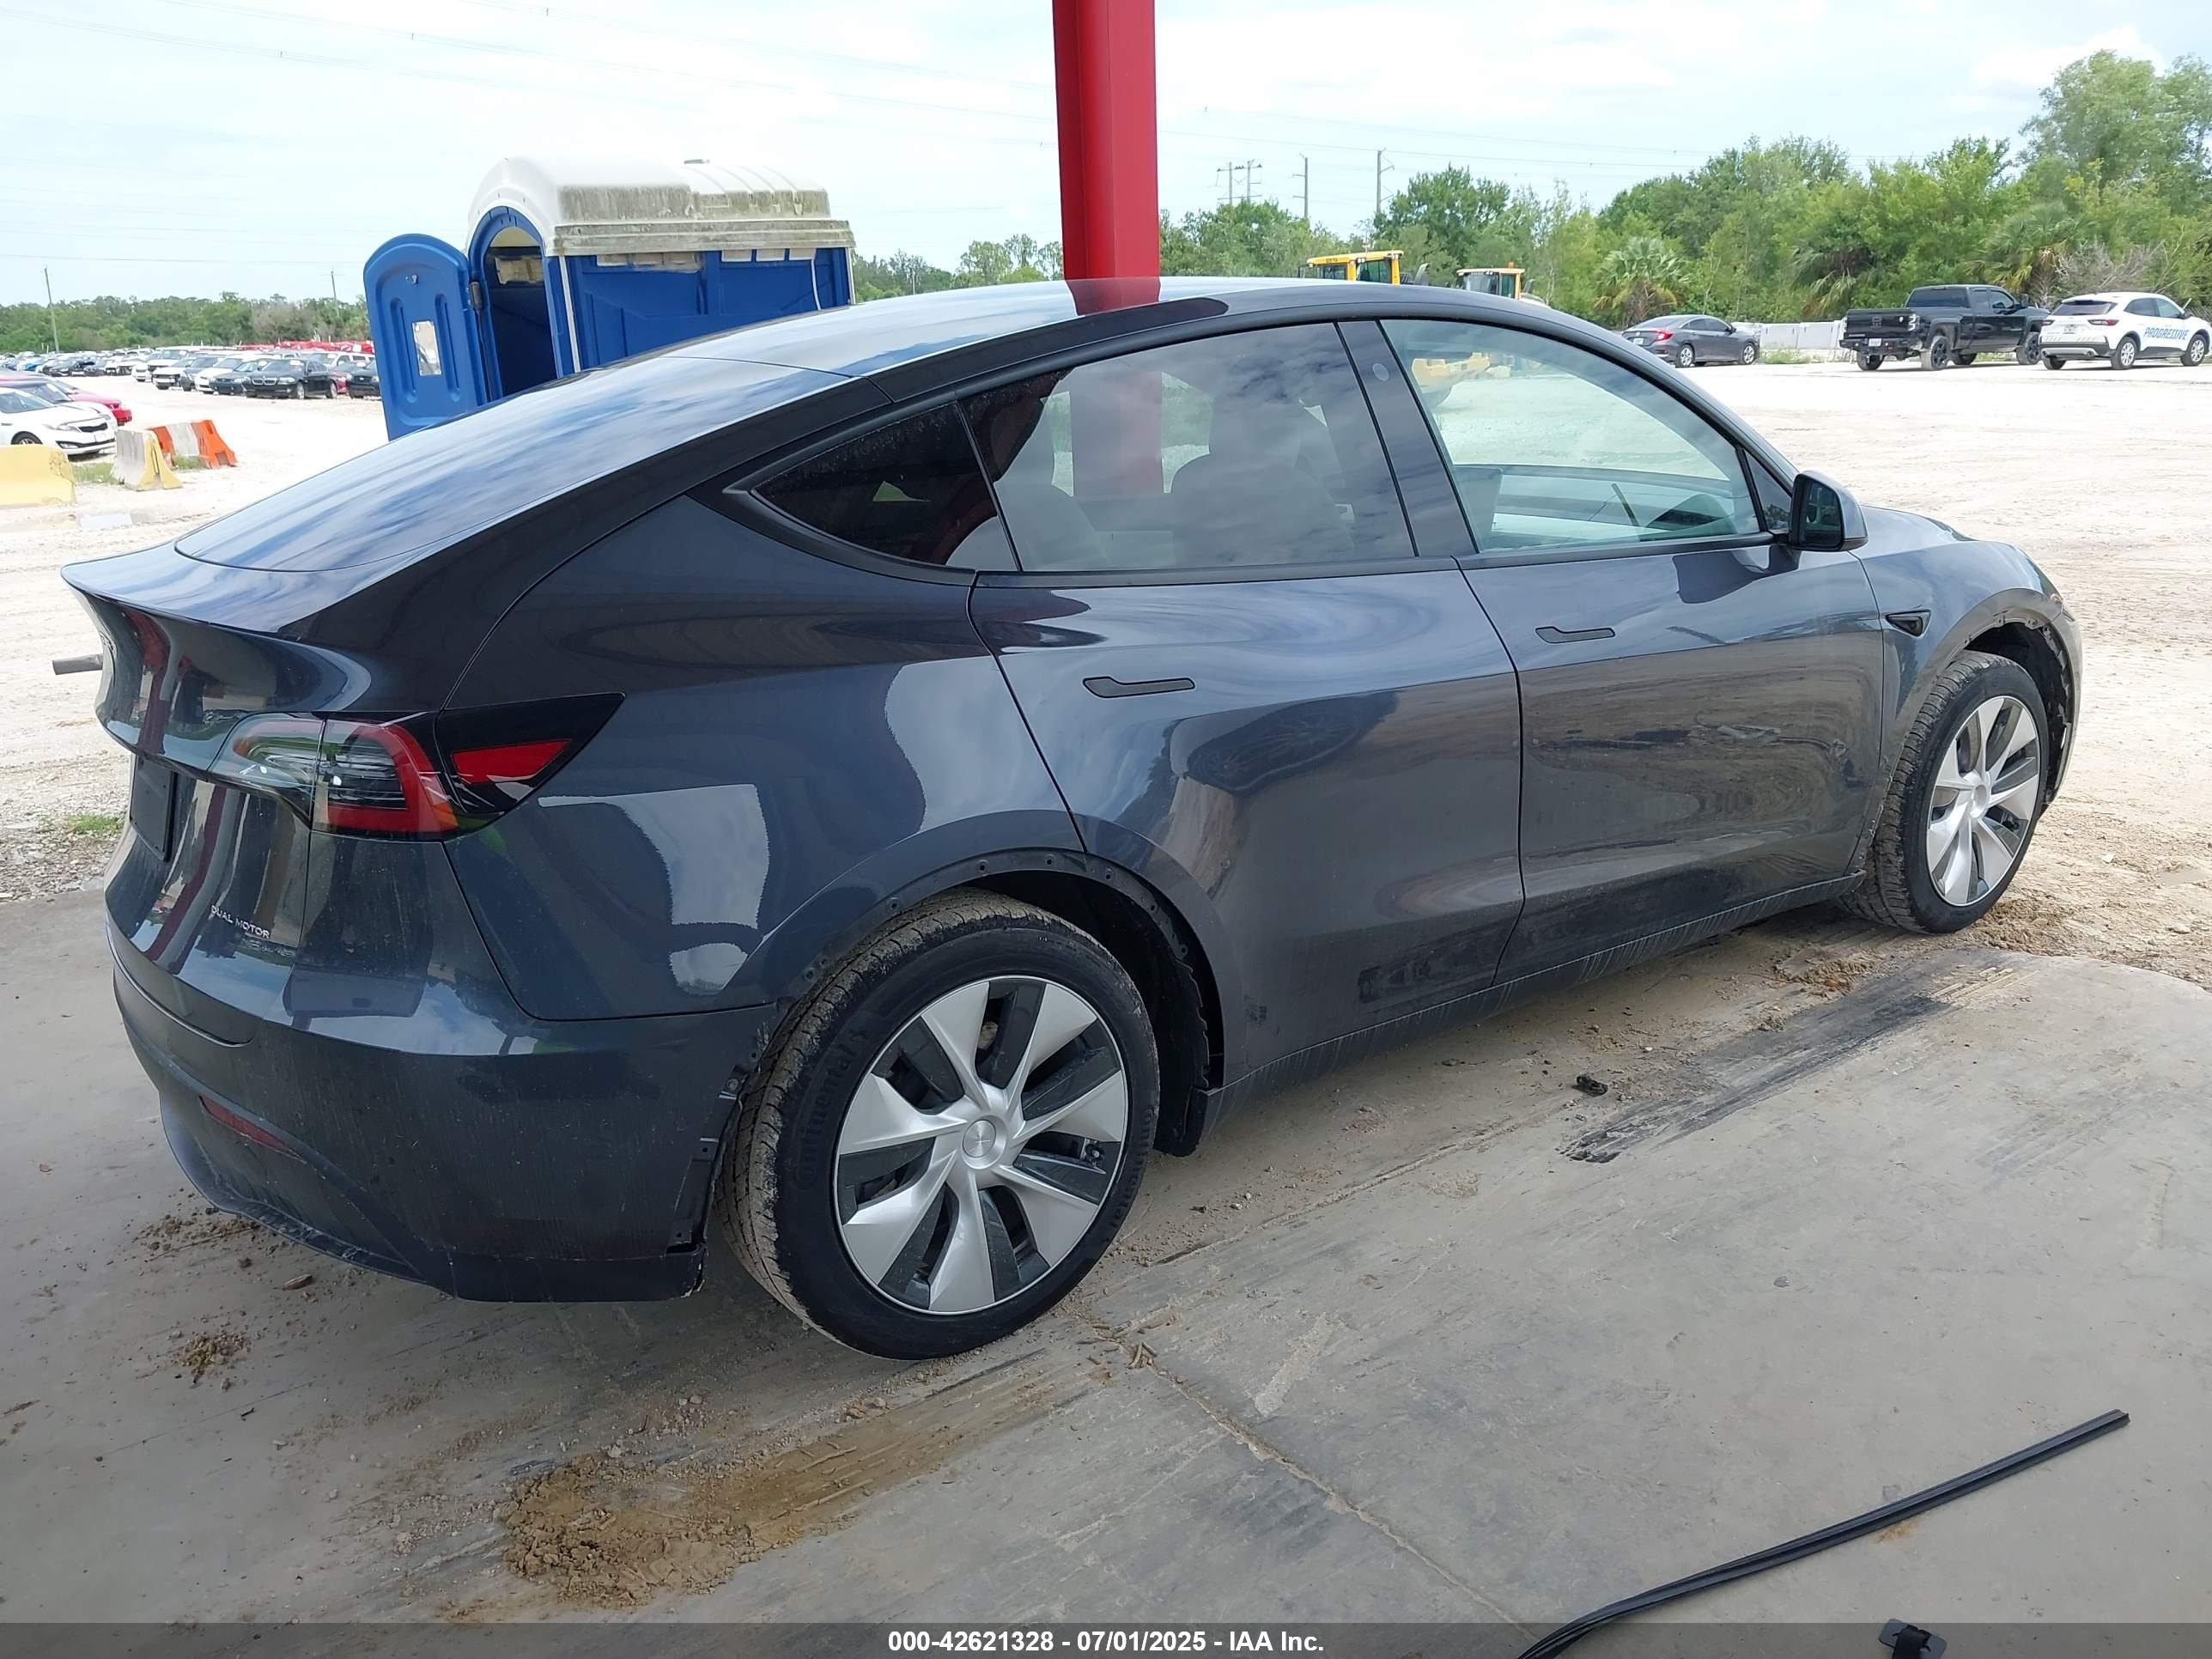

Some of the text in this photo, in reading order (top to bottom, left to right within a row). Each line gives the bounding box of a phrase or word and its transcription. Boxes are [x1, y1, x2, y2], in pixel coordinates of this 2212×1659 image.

[2143, 326, 2190, 339] PROGRESSIVE
[211, 904, 270, 939] DUAL MOTOR
